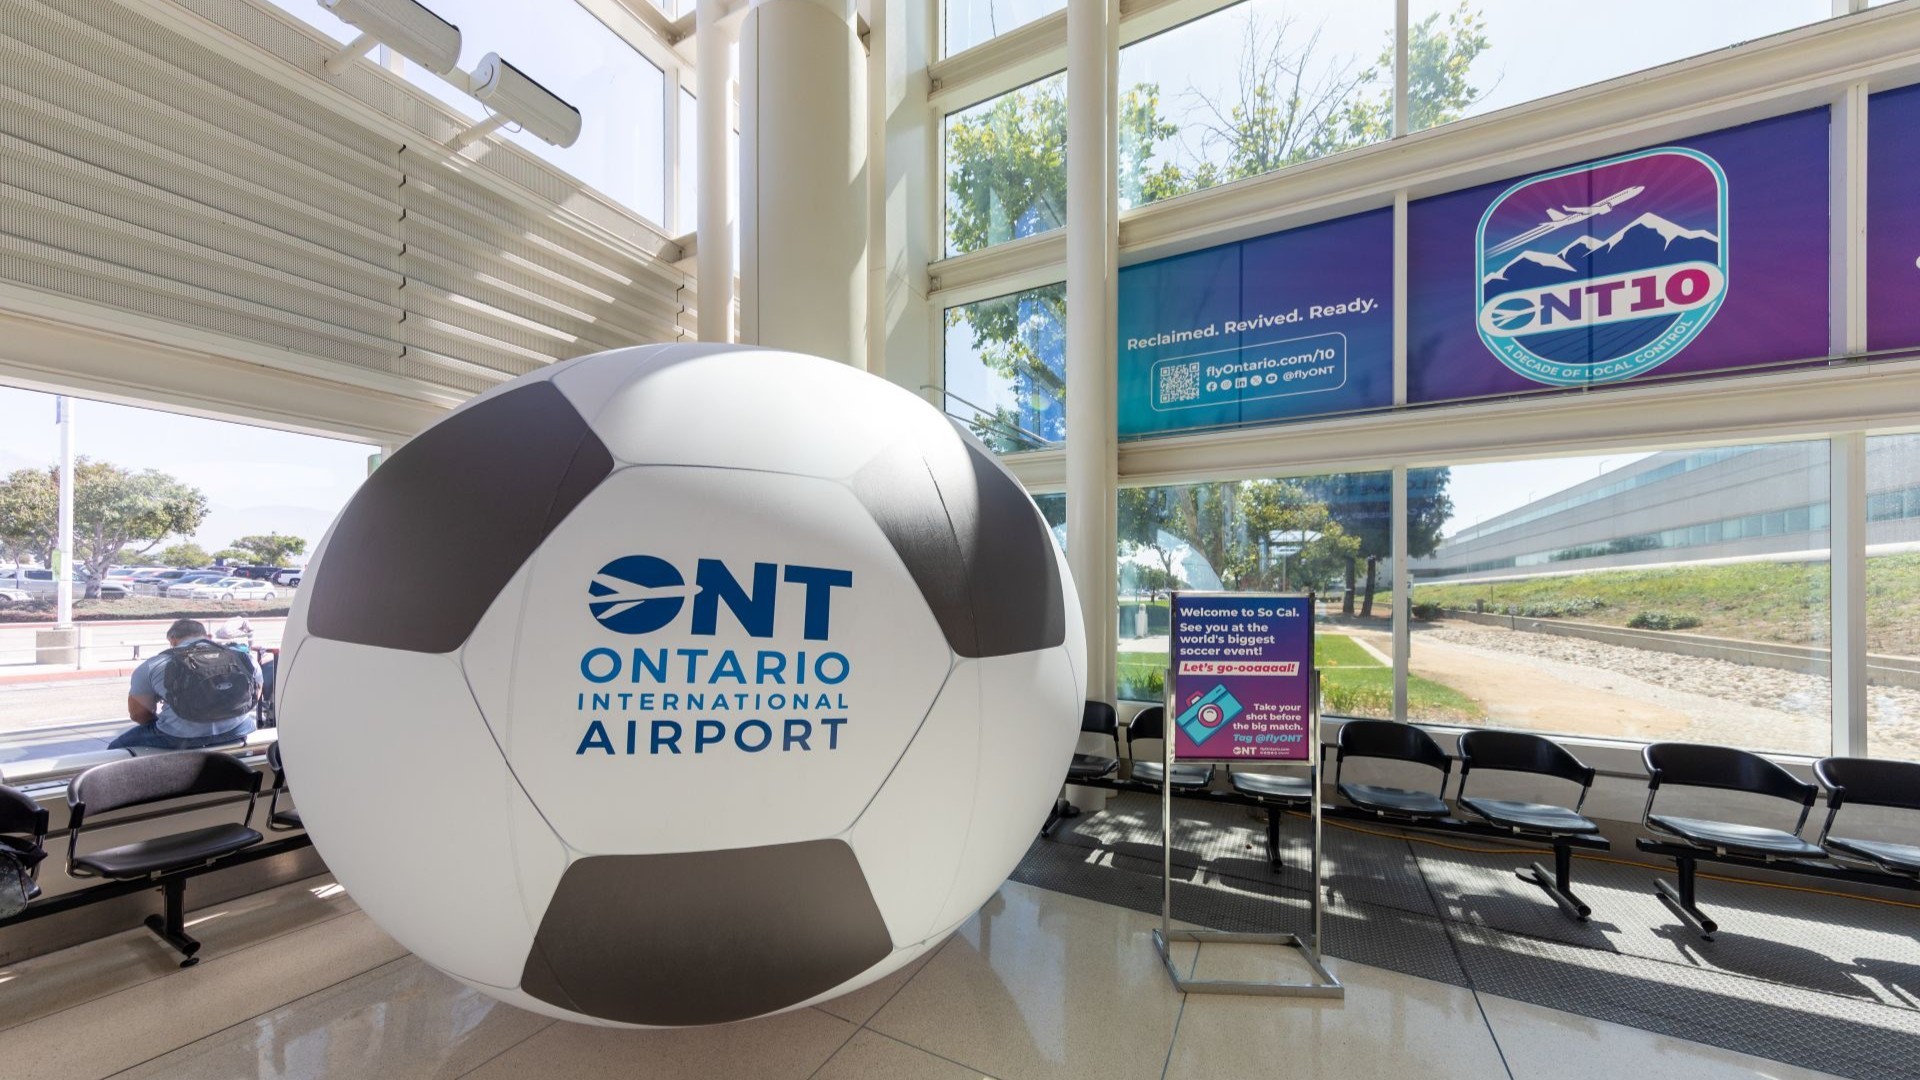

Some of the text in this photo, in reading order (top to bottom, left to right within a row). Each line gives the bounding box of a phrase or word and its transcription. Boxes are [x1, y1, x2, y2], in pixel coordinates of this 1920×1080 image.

[1491, 268, 1711, 331] ONT10
[1127, 297, 1379, 350] Reclaimed. Revived. Ready.
[1503, 319, 1694, 378] A DECADE OF LOCAL CONTROL
[1206, 348, 1335, 378] flyOntario.com/10
[1283, 365, 1336, 382] @flyONT
[588, 554, 853, 641] ONT
[1179, 607, 1300, 617] Welcome to So Cal.
[1179, 622, 1269, 634] See you at the
[1179, 633, 1276, 646] world's biggest
[1179, 646, 1263, 656] soccer event!
[580, 647, 850, 685] ONTARIO
[1216, 663, 1296, 674] go-ooaaaal!
[577, 693, 849, 710] INTERNATIONAL
[1253, 703, 1277, 711] Take
[1245, 713, 1302, 721] shot before
[1232, 722, 1304, 732] the big match.
[575, 717, 848, 755] AIRPORT
[1233, 733, 1304, 744] Tag @flyONT
[1232, 746, 1257, 755] ONT
